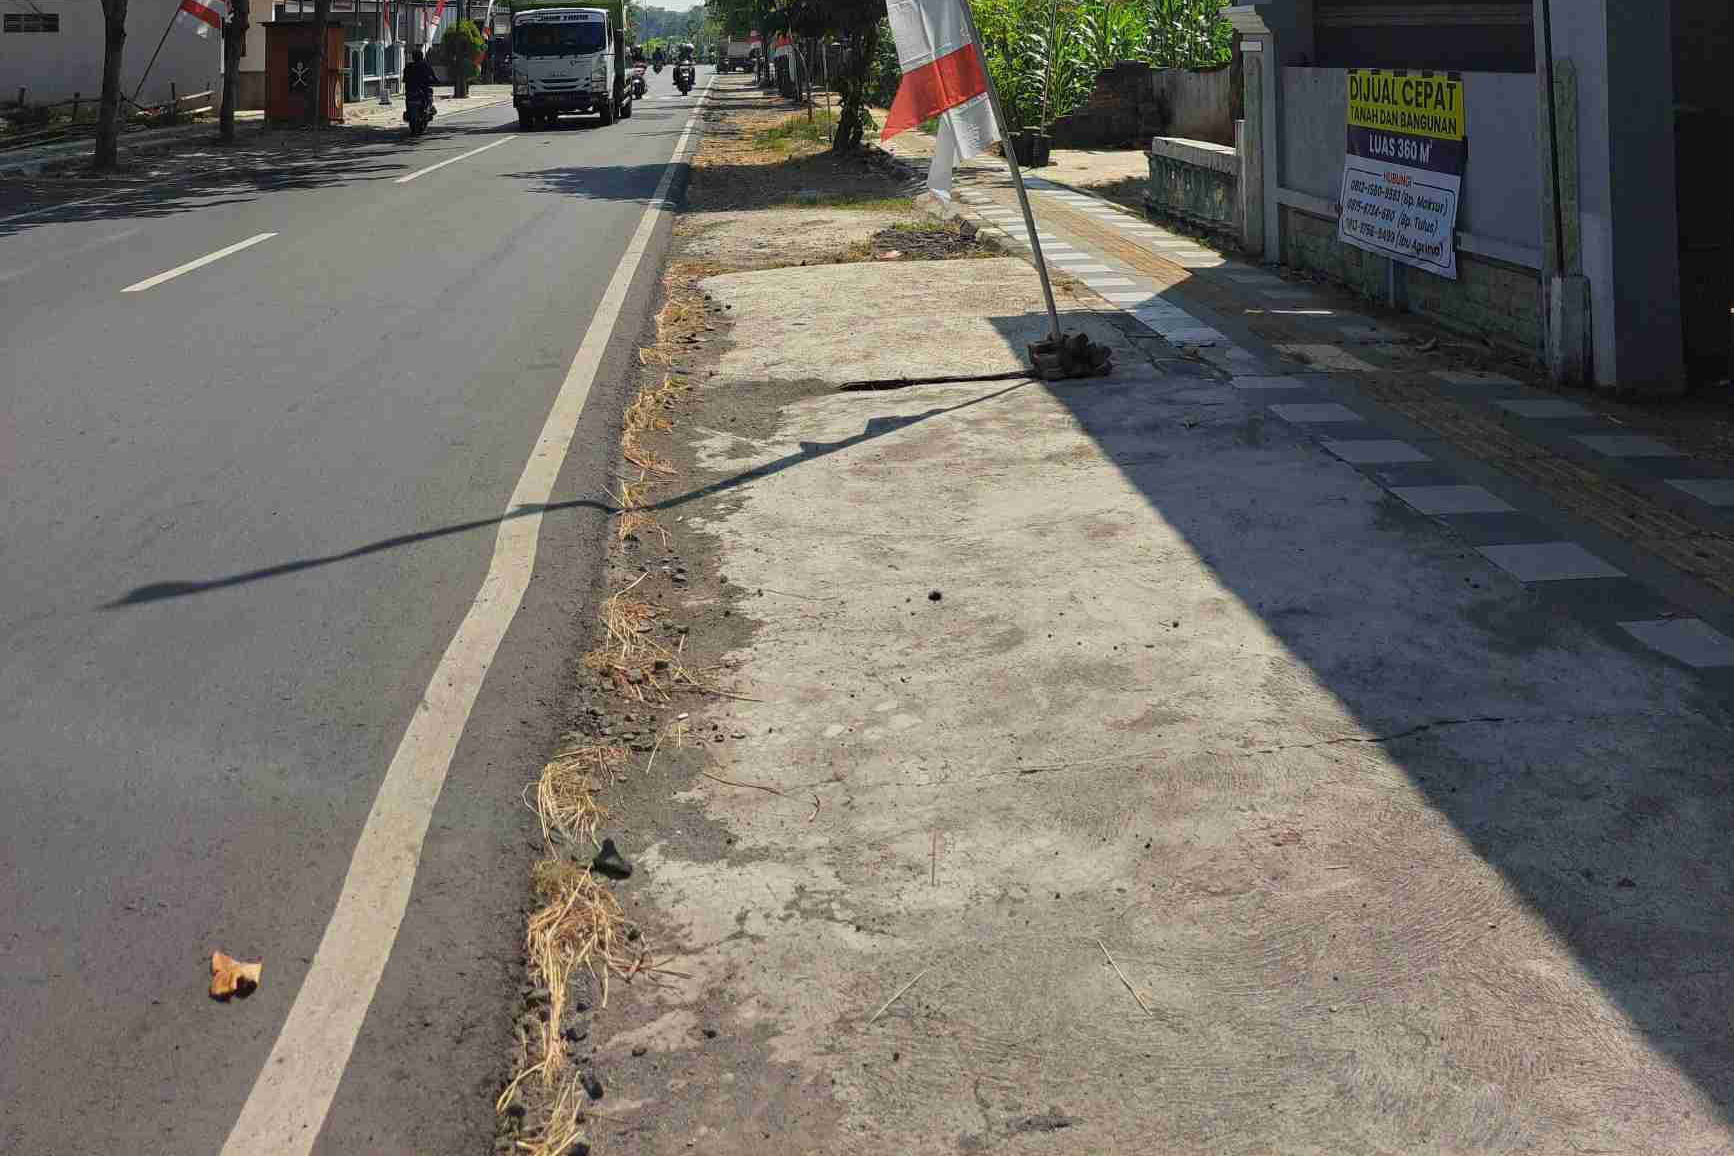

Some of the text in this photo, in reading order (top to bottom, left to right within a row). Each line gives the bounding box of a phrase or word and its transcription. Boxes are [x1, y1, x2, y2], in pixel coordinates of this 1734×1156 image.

[1350, 75, 1457, 112] DIJUAL CEPAT
[1351, 106, 1457, 135] TANAH DAN BANGUNAN
[1369, 132, 1395, 156] LUAS
[1397, 138, 1418, 161] 360
